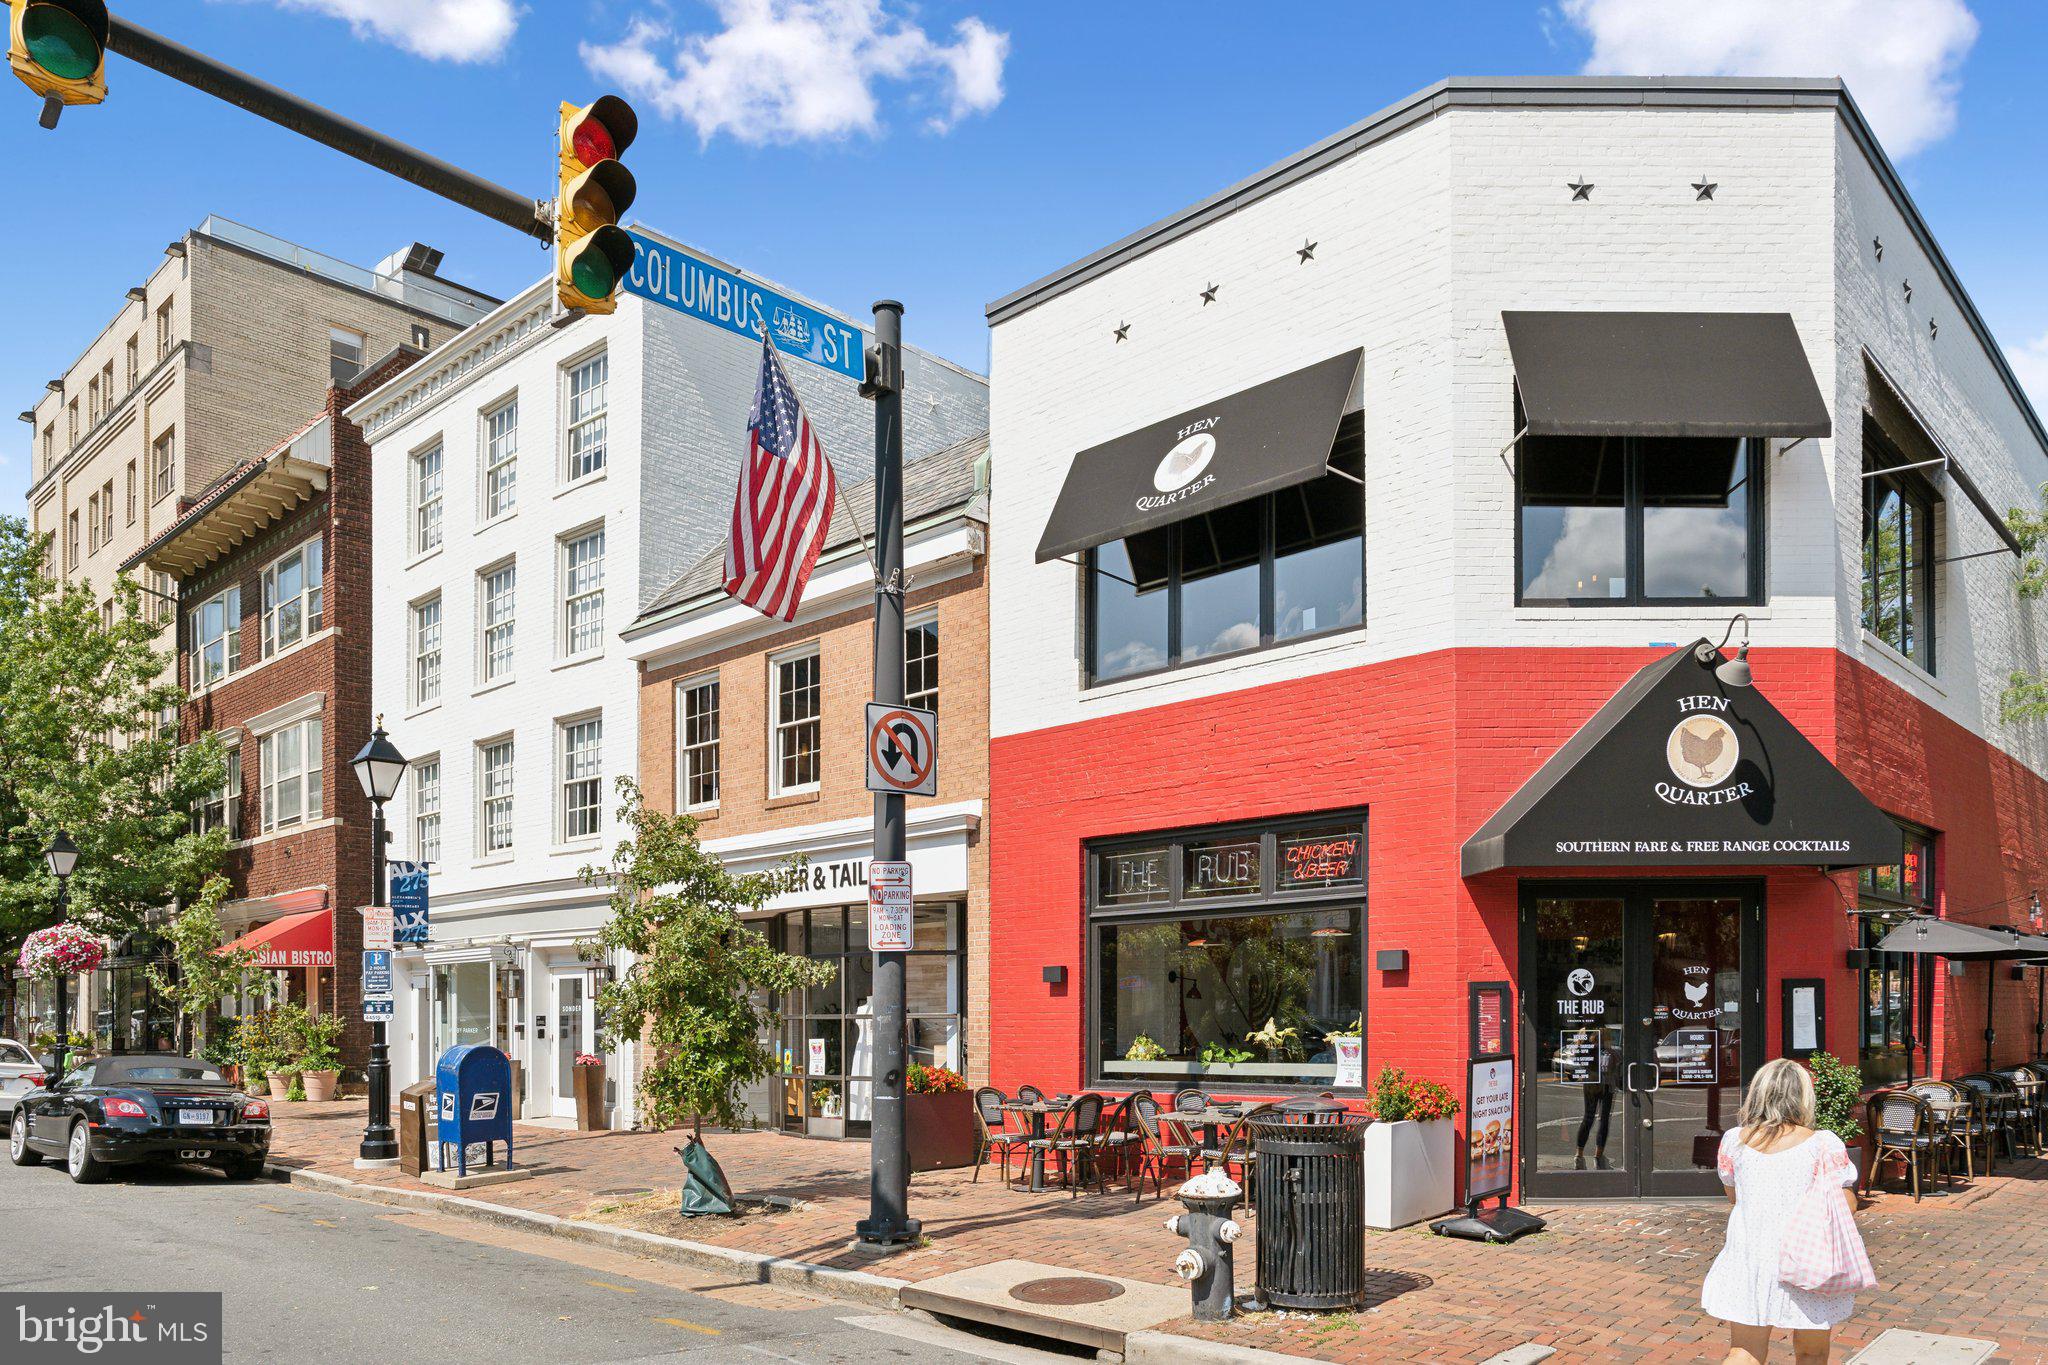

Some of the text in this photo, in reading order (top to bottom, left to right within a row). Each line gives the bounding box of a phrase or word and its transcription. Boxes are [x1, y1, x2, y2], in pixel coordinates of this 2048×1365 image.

[630, 240, 852, 370] COLUMBUS ST
[1177, 416, 1221, 441] HEN
[1135, 474, 1217, 511] QUARTER
[1677, 695, 1731, 712] HEN
[1655, 782, 1754, 805] QUARTER
[1287, 840, 1356, 862] CHICKEN
[1556, 840, 1850, 853] SOUTHERN FARE & FREE RANGE COCKTAILS
[390, 860, 428, 880] ALX
[813, 866, 826, 890] &
[829, 861, 868, 888] TAIL
[872, 867, 909, 876] NO PARKING
[1119, 850, 1250, 893] THE RUB
[400, 871, 429, 892] 275
[872, 889, 910, 902] NO PARKING
[393, 910, 428, 931] ALX
[875, 923, 907, 931] LOADING
[400, 924, 428, 942] 275
[882, 931, 901, 939] ZONE
[252, 950, 332, 965] ASIAN BISTRO
[373, 953, 382, 965] P
[1683, 966, 1710, 975] HEN
[1557, 1000, 1605, 1014] THE RUB
[1672, 1008, 1723, 1020] QUARTER
[1476, 1092, 1509, 1106] GET YOUR LATE
[1472, 1105, 1511, 1119] NIGHT SNACK ON
